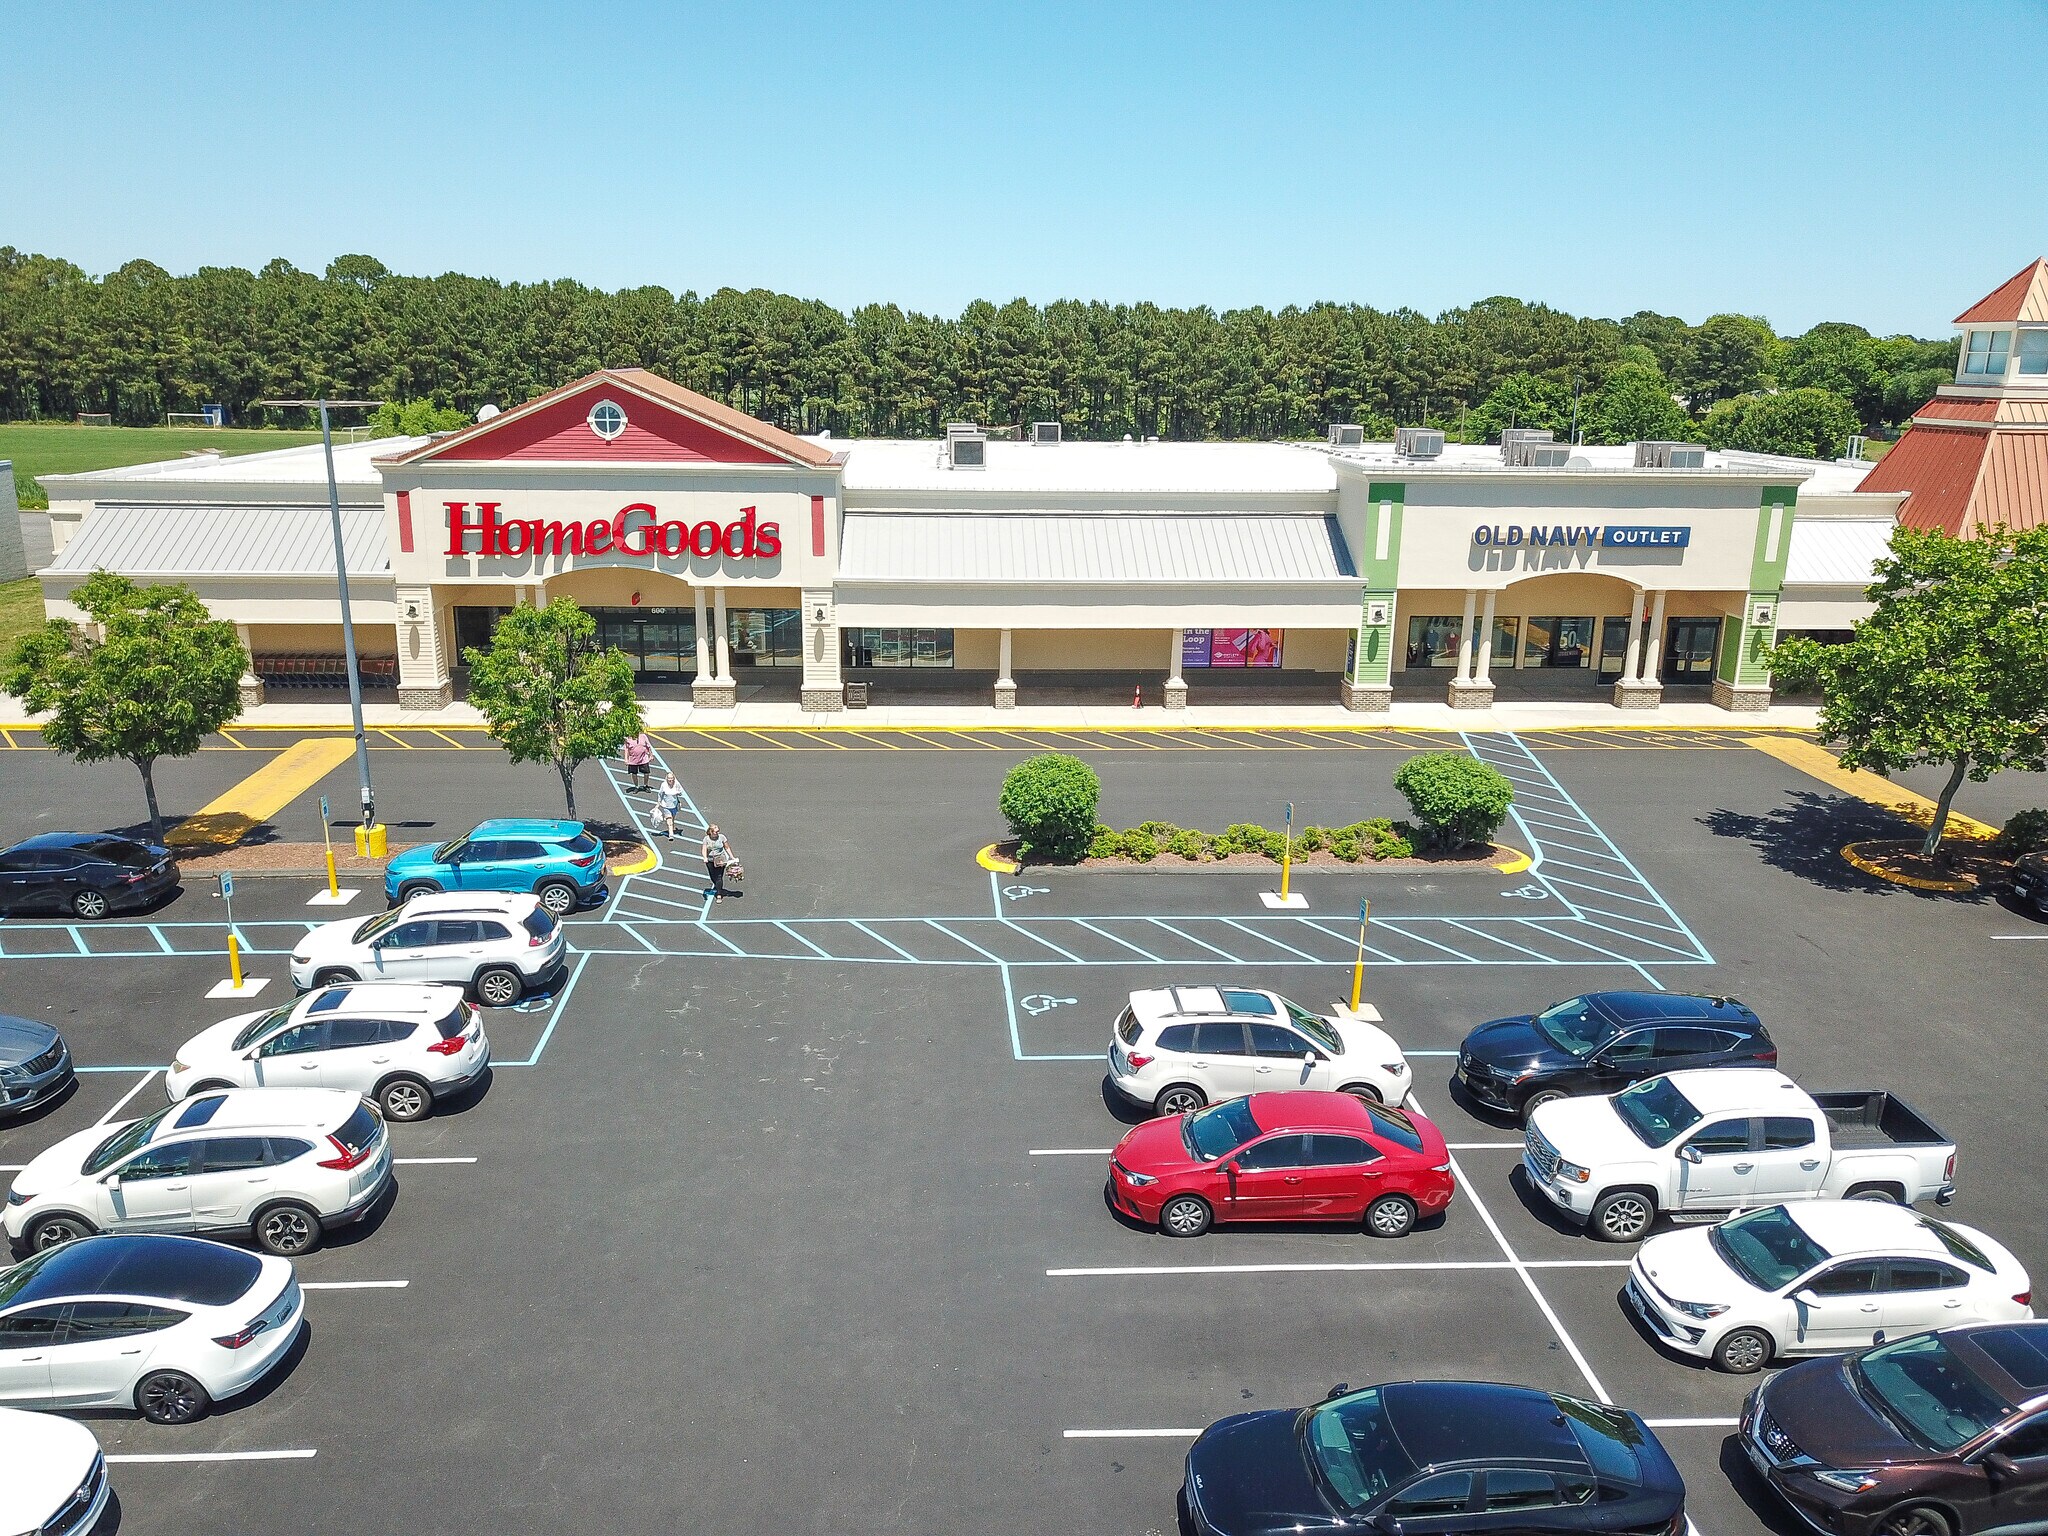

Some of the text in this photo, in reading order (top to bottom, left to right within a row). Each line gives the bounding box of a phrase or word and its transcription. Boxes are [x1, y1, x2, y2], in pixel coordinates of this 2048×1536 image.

[443, 502, 782, 558] HomeGoods
[1474, 525, 1682, 547] OLD NAVY OUTLET
